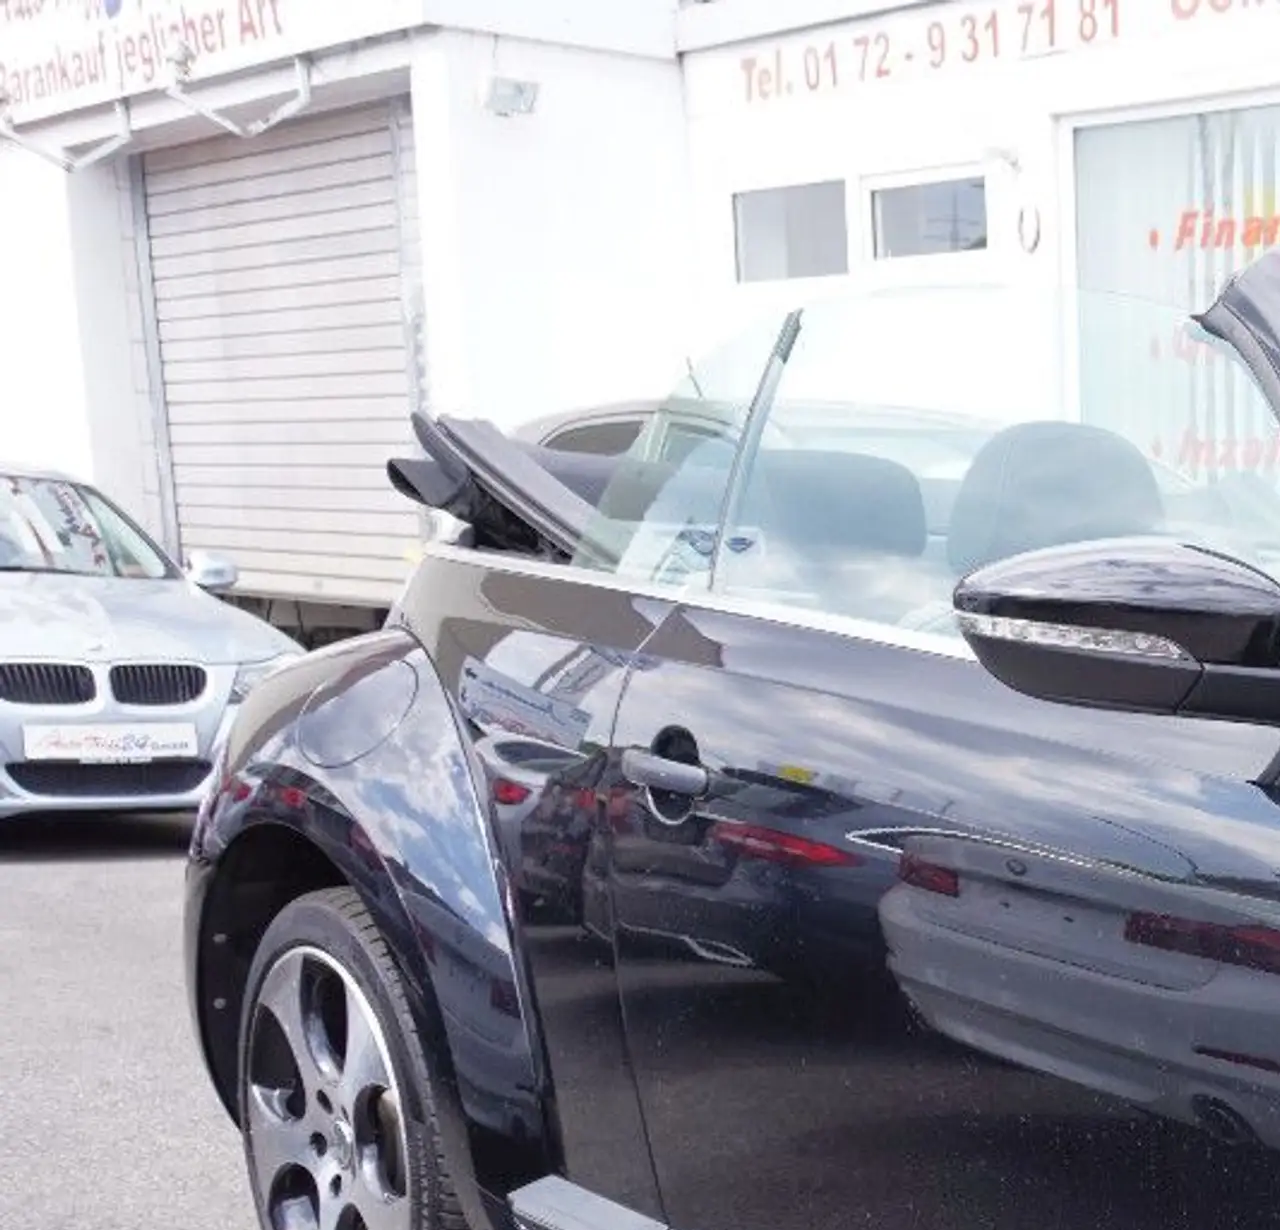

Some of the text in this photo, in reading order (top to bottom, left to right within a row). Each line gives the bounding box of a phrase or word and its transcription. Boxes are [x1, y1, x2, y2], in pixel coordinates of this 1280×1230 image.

[238, 0, 284, 46] Art
[740, 48, 794, 103] Tel.
[803, 41, 839, 91] 01
[853, 32, 892, 81] 72
[960, 9, 1001, 63] 31
